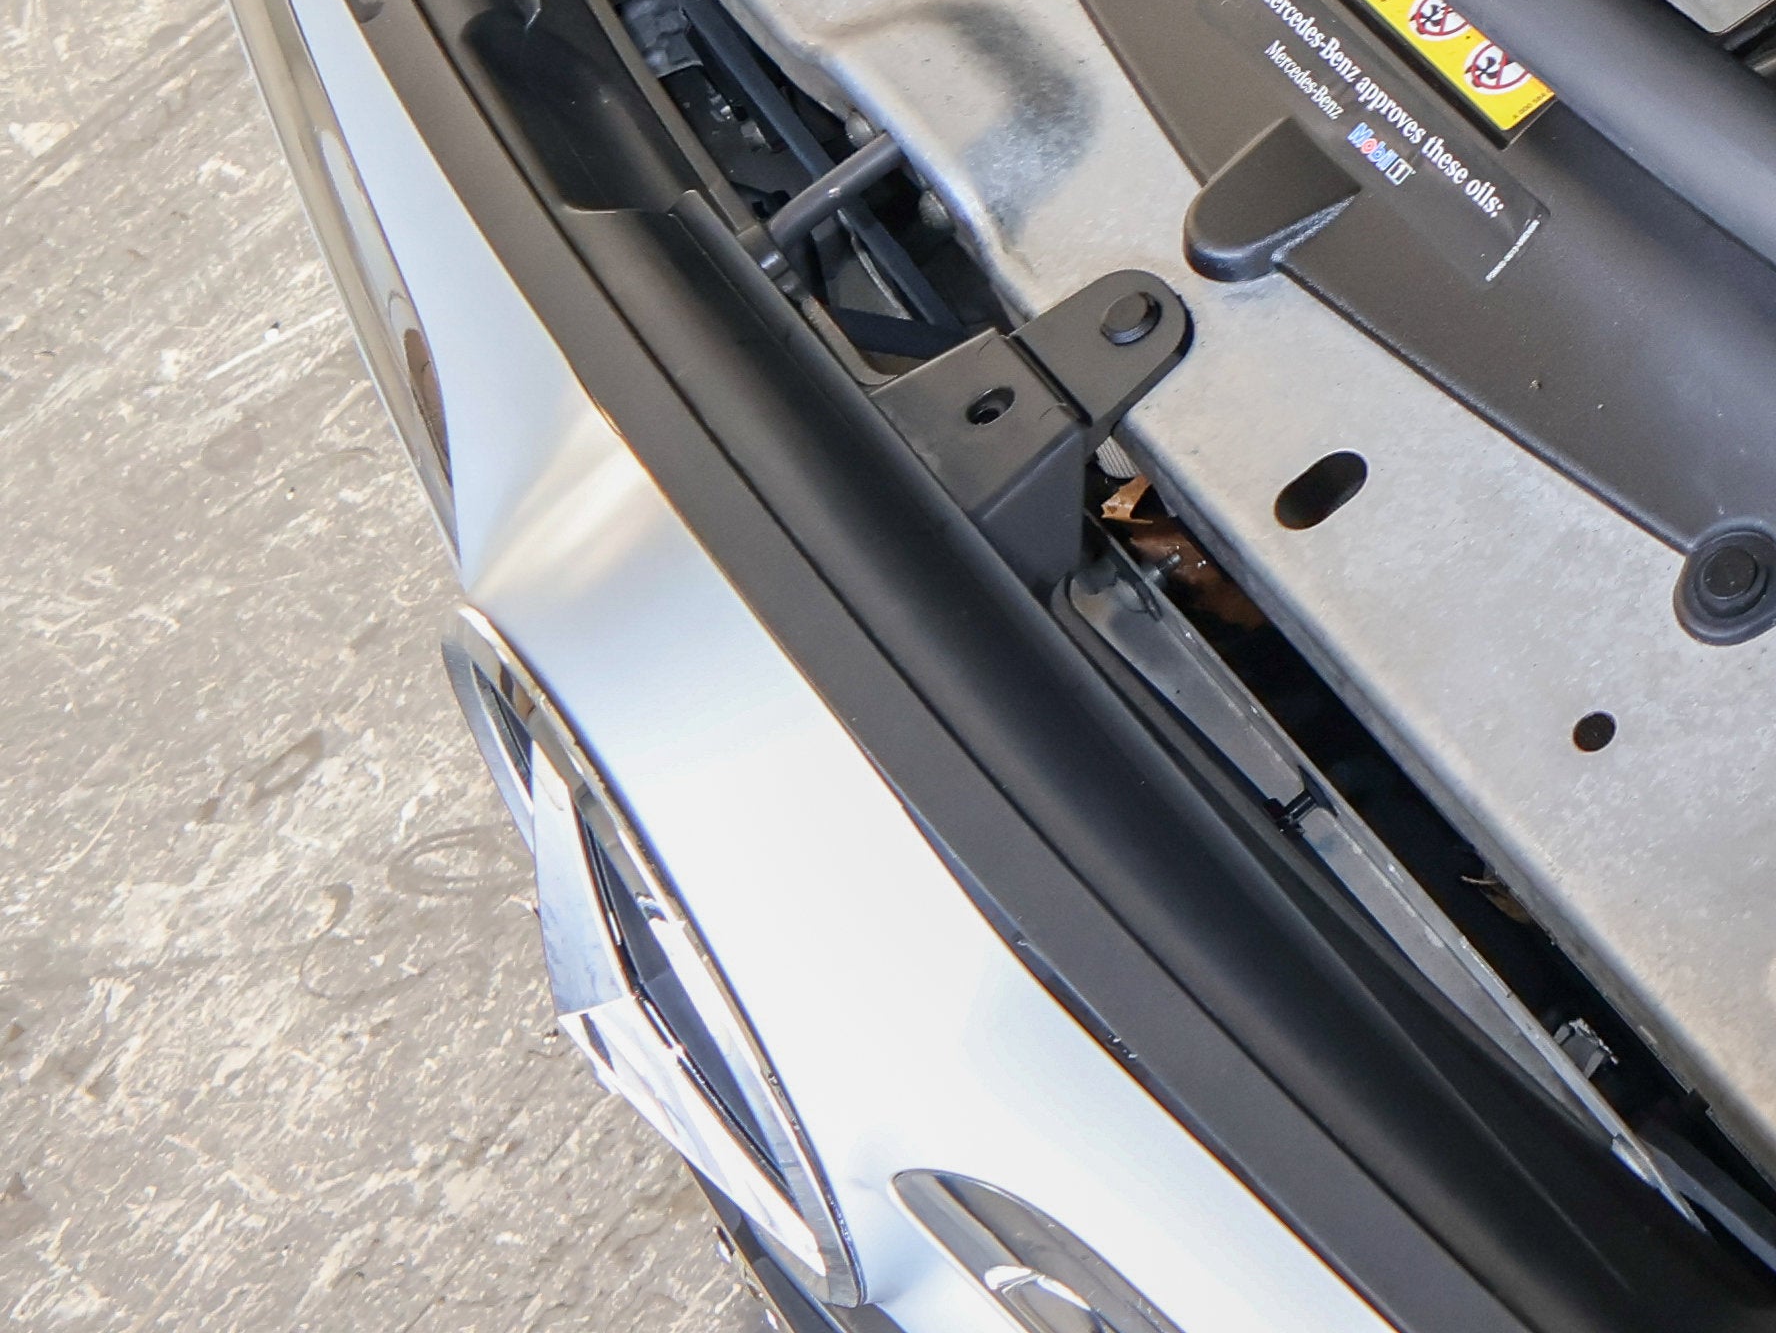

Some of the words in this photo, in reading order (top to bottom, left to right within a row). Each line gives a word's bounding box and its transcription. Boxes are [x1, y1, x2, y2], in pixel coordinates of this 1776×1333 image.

[1265, 39, 1345, 120] Mercedes-Benz
[1346, 121, 1398, 172] Mobil
[1355, 74, 1426, 145] approves
[1421, 135, 1468, 183] these
[1466, 177, 1504, 218] oils:
